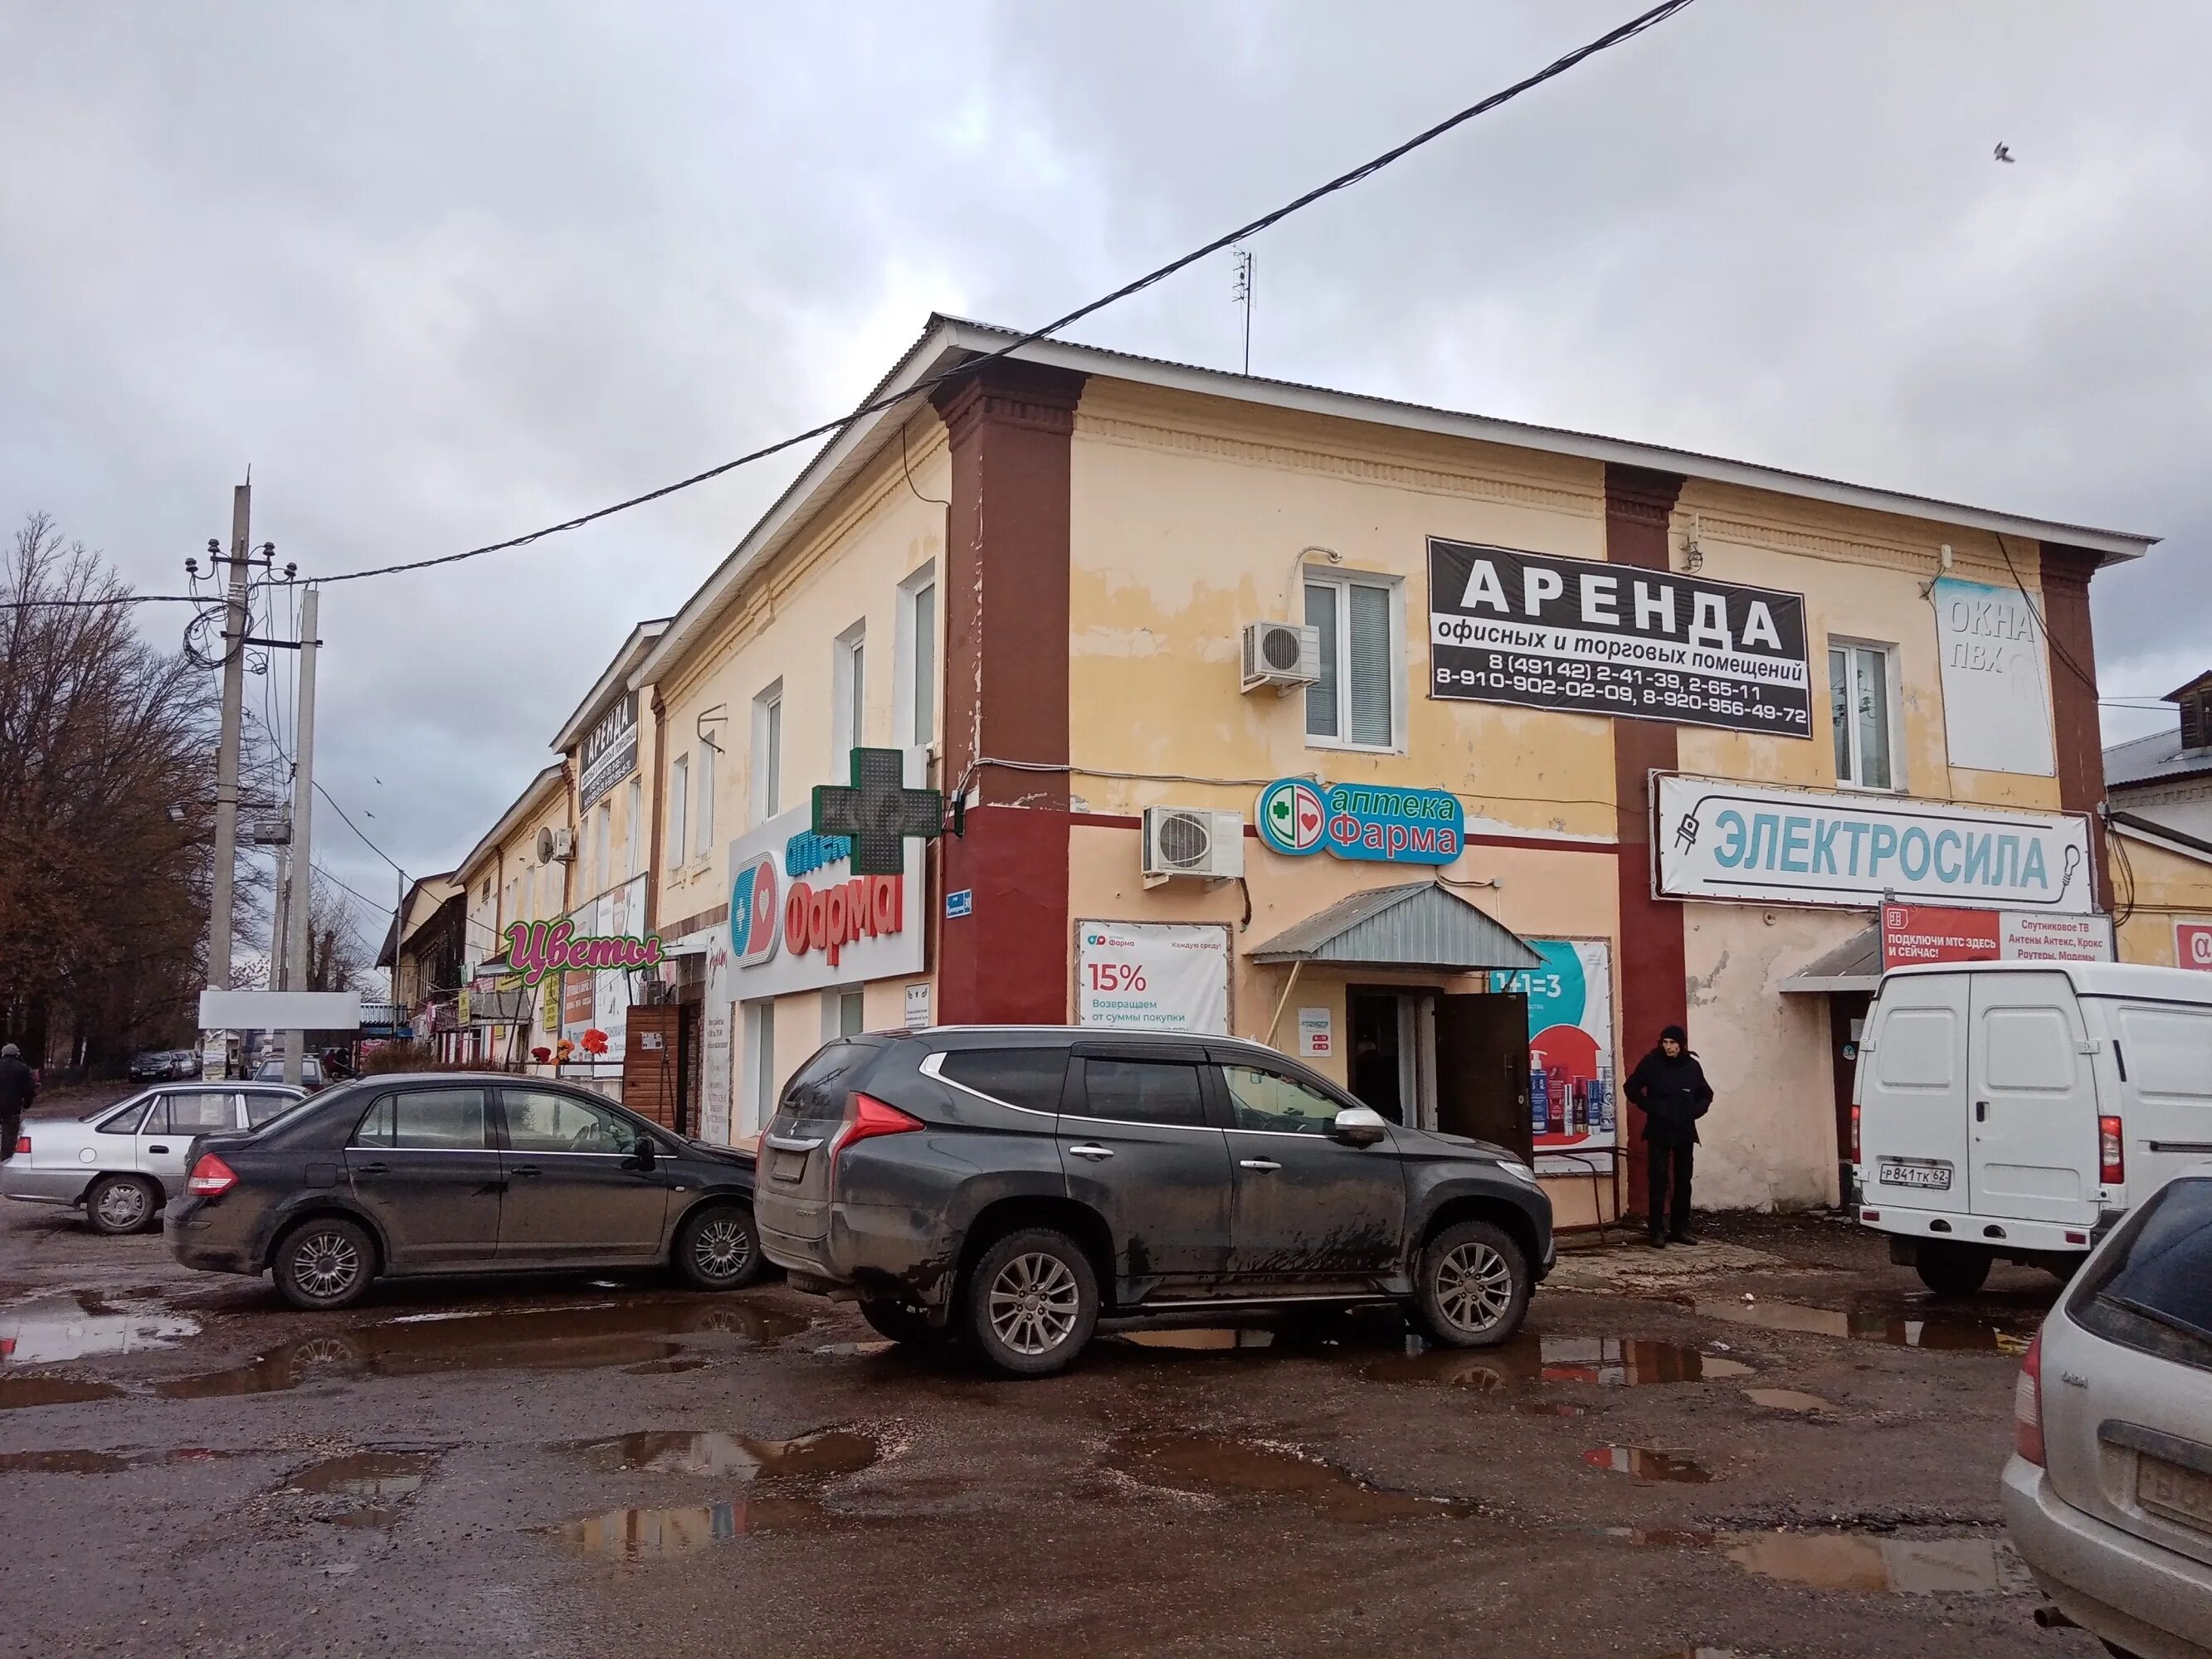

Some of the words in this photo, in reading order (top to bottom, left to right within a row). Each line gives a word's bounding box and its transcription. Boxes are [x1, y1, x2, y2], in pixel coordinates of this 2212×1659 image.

[1459, 559, 1782, 652] АРЕНДА
[1951, 601, 2035, 643] ОКНА
[1437, 619, 1545, 649] офисных
[1553, 636, 1567, 651] и
[1574, 638, 1687, 666] торговых
[1691, 651, 1804, 683] помещений
[1951, 642, 2003, 674] ПВХ
[1435, 667, 1637, 706] 8-910-902-02-09,
[1643, 692, 1807, 724] 8-920-956-49-72
[1488, 654, 1503, 669] 8
[1508, 655, 1591, 681] (49142)
[1596, 668, 1684, 693] 2-41-39,
[1689, 677, 1761, 701] 2-65-11
[587, 696, 629, 765] АРЕНДА
[1330, 789, 1454, 820] аптека
[785, 830, 851, 877] аптек
[1328, 811, 1458, 859] Фарма
[1713, 810, 2049, 890] ЭЛЕКТРОСИЛА
[784, 875, 903, 966] Фарма
[1888, 934, 1944, 946] ПОДКЛЮЧИ
[1945, 937, 1966, 947] МТС
[1966, 938, 1997, 949] ЗДЕСЬ
[2009, 934, 2042, 944] Антены
[2044, 936, 2076, 947] Антекс,
[2078, 937, 2103, 949] Крокс
[2021, 919, 2078, 932] Спутниковое
[2078, 922, 2089, 932] ТВ
[507, 921, 664, 985] Цветы
[1888, 946, 1896, 956] И
[1898, 945, 1939, 958] СЕЙЧАС!
[1088, 963, 1147, 992] 15%
[1092, 999, 1157, 1010] Возвращаем
[1106, 1014, 1141, 1023] суммы
[1143, 1014, 1185, 1023] покупки
[1885, 1167, 1930, 1182] Р841ТК
[1932, 1170, 1945, 1181] 62
